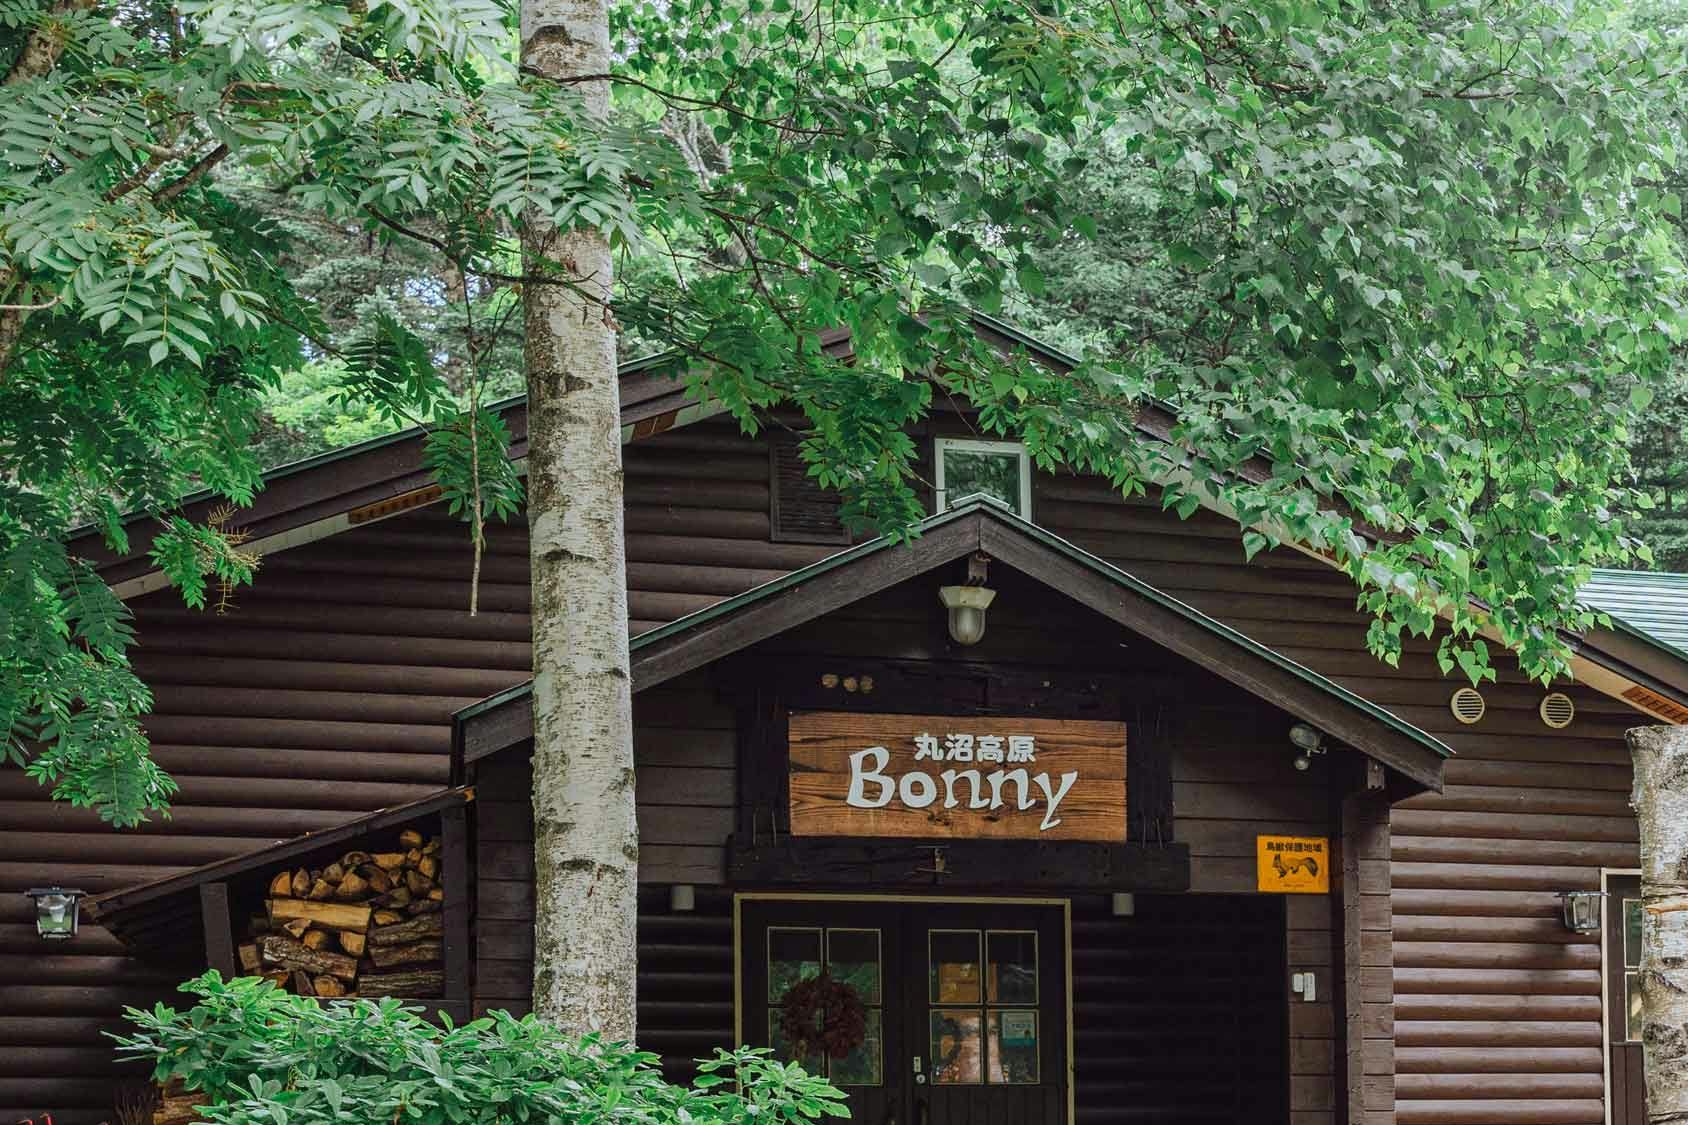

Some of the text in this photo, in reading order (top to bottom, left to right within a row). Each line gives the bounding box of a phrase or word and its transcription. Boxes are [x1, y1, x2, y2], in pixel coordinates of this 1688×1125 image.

[914, 732, 1037, 763] 丸沼高原
[845, 745, 1079, 832] Bonny
